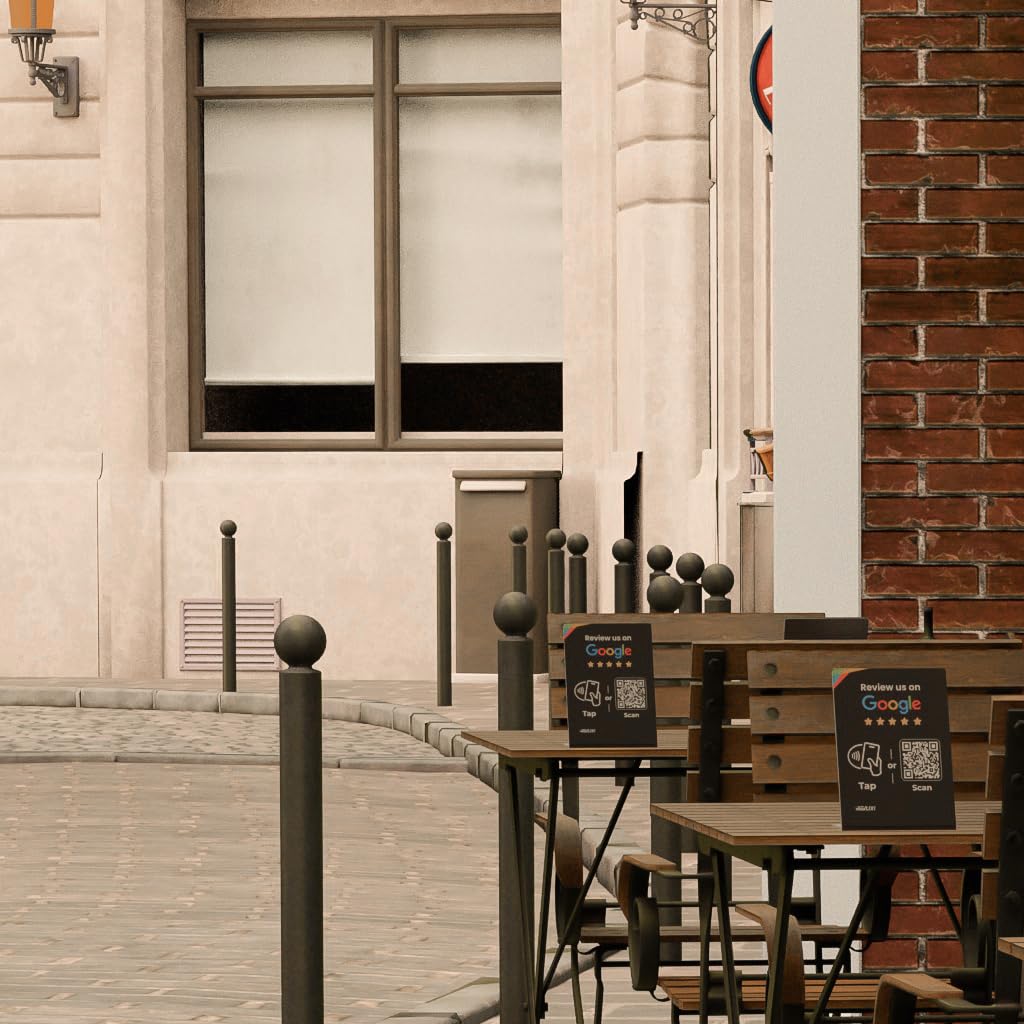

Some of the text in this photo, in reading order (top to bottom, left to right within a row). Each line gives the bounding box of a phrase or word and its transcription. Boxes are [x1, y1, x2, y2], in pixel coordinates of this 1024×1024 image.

[585, 643, 632, 659] Google
[860, 683, 893, 692] Review
[895, 684, 907, 692] us
[861, 695, 922, 714] Google
[582, 710, 597, 718] Tap
[858, 782, 877, 791] Tap
[912, 784, 933, 792] Scan
